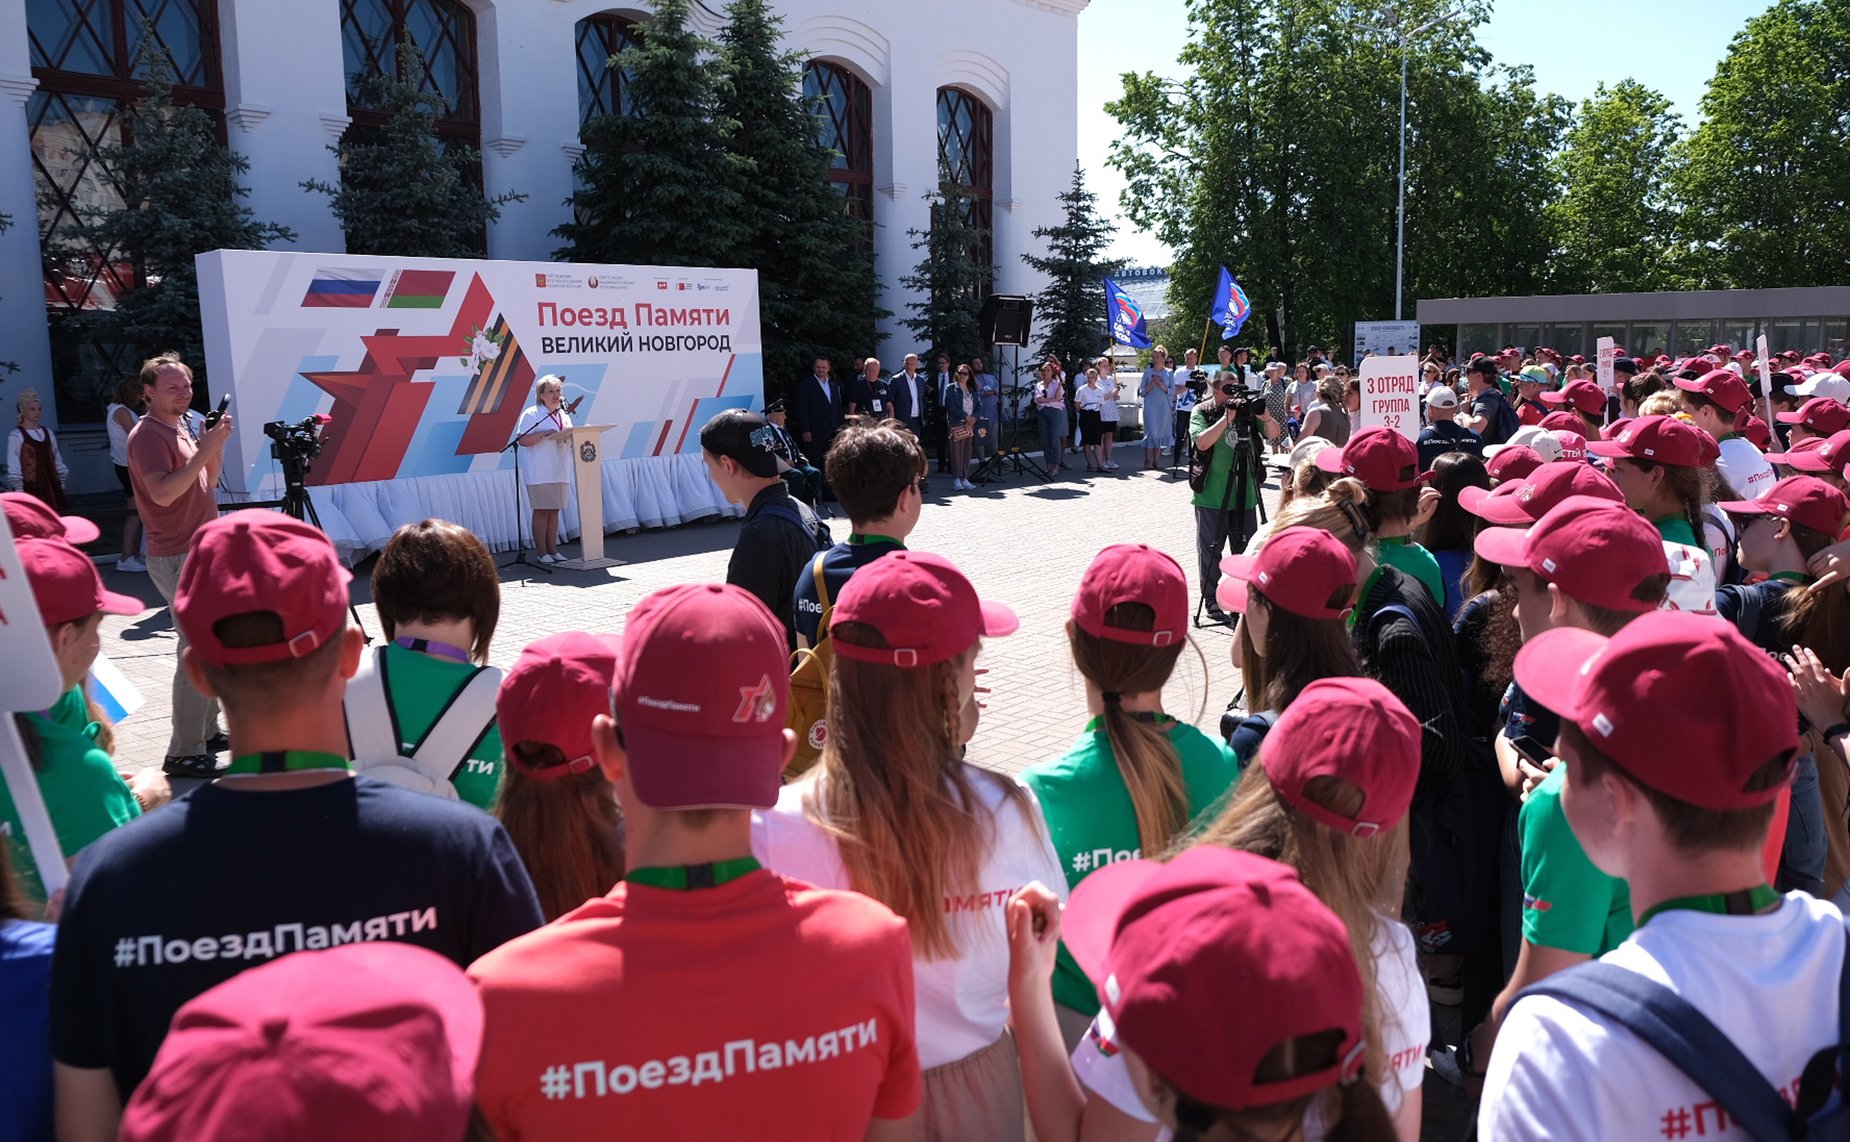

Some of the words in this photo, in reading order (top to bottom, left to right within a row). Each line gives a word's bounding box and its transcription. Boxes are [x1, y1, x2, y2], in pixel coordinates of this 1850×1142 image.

[1114, 268, 1163, 278] АВТОВОК
[537, 301, 628, 330] Поезд
[634, 302, 731, 327] Памяти
[541, 331, 634, 354] ВЕЛИКИЙ
[638, 334, 732, 353] НОВГОРОД
[1367, 377, 1375, 394] 3
[1377, 375, 1415, 394] ОТРЯД
[1372, 398, 1410, 414] ГРУППА
[1384, 414, 1401, 428] 3-2
[798, 597, 824, 614] #Пое
[466, 759, 495, 775] ти
[113, 905, 438, 968] #ПоездПамяти
[540, 1018, 878, 1101] #ПоездПамяти
[1392, 1043, 1422, 1071] яти
